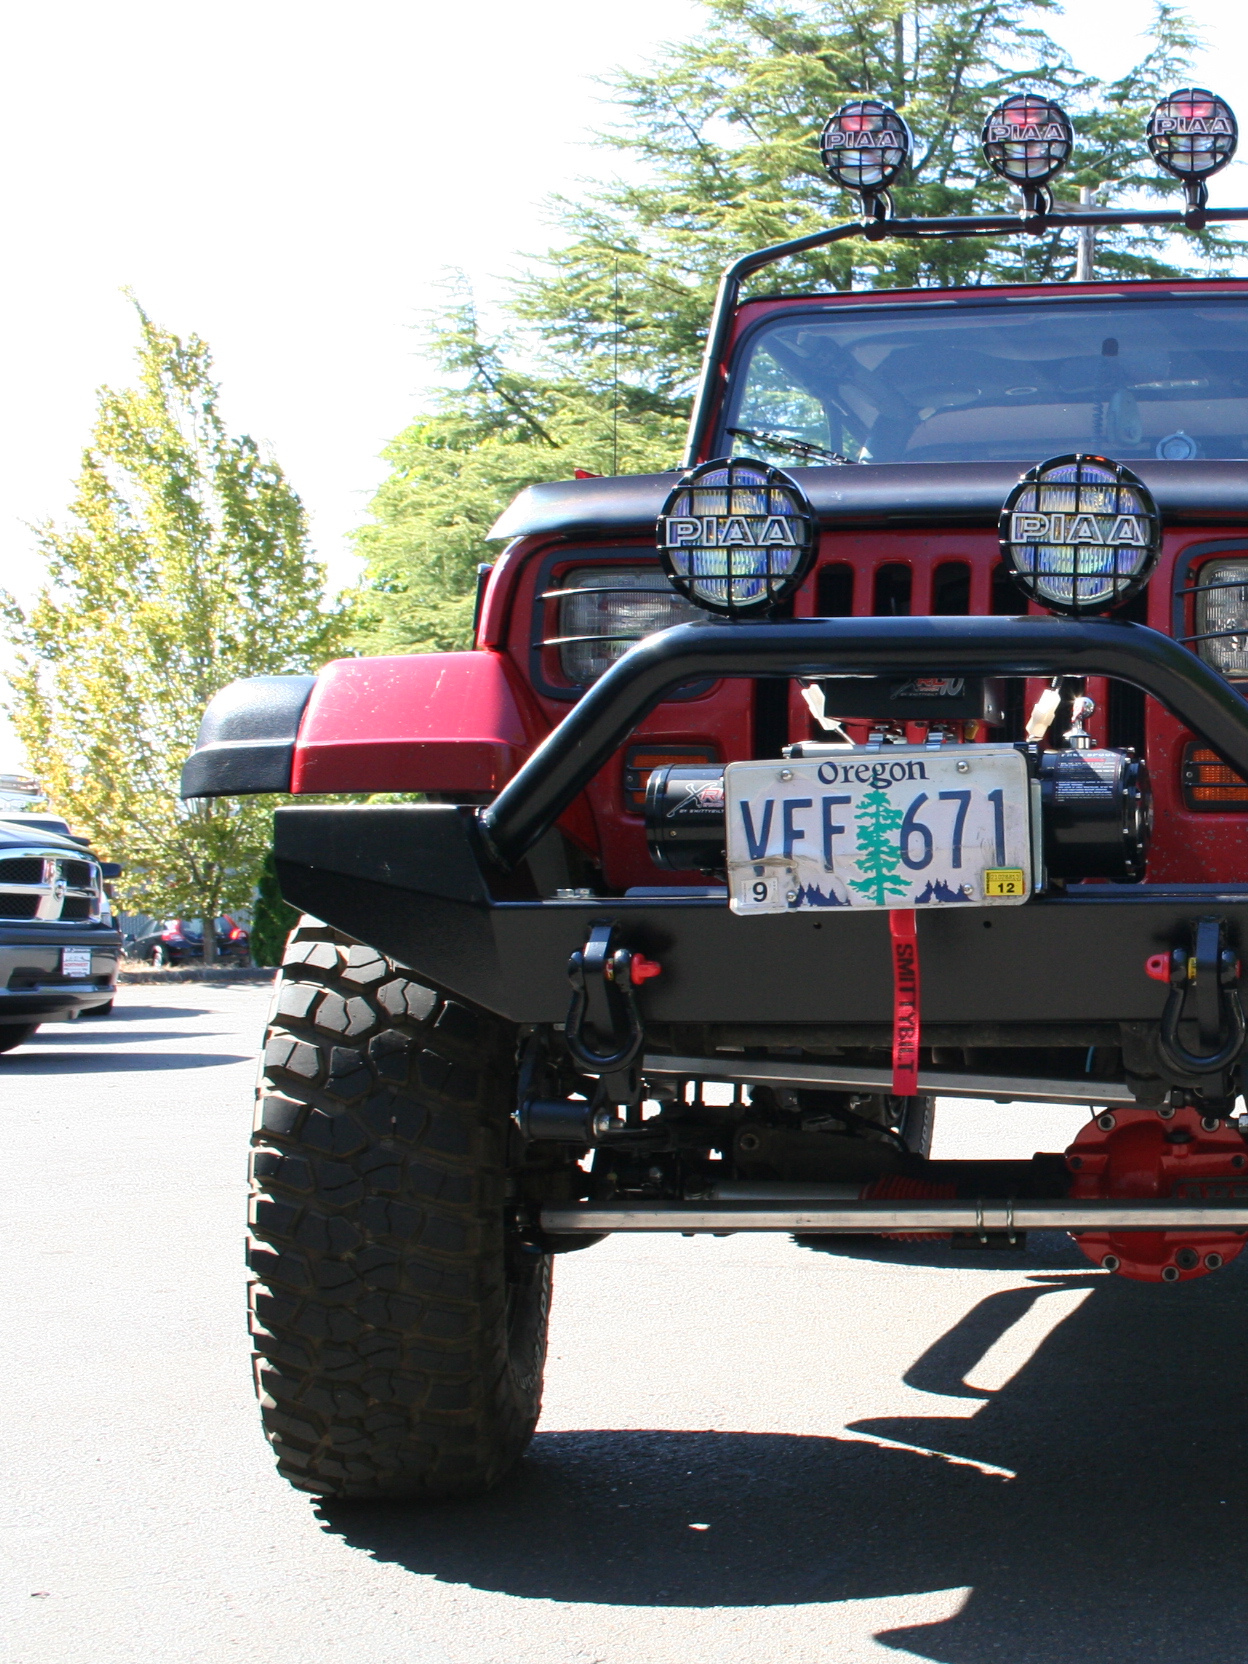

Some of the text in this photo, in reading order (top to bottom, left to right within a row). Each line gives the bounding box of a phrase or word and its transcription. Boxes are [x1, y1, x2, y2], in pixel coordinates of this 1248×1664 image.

[989, 123, 1065, 142] PIAA
[1155, 117, 1232, 135] PIAA
[825, 130, 898, 149] PIAA
[665, 515, 798, 547] PIAA
[1010, 511, 1147, 546] PIAA
[817, 760, 930, 789] Oregon
[740, 789, 1006, 876] VFF 671
[752, 882, 768, 902] 9
[998, 883, 1015, 893] 12
[896, 943, 916, 1074] SMITTYBILT
